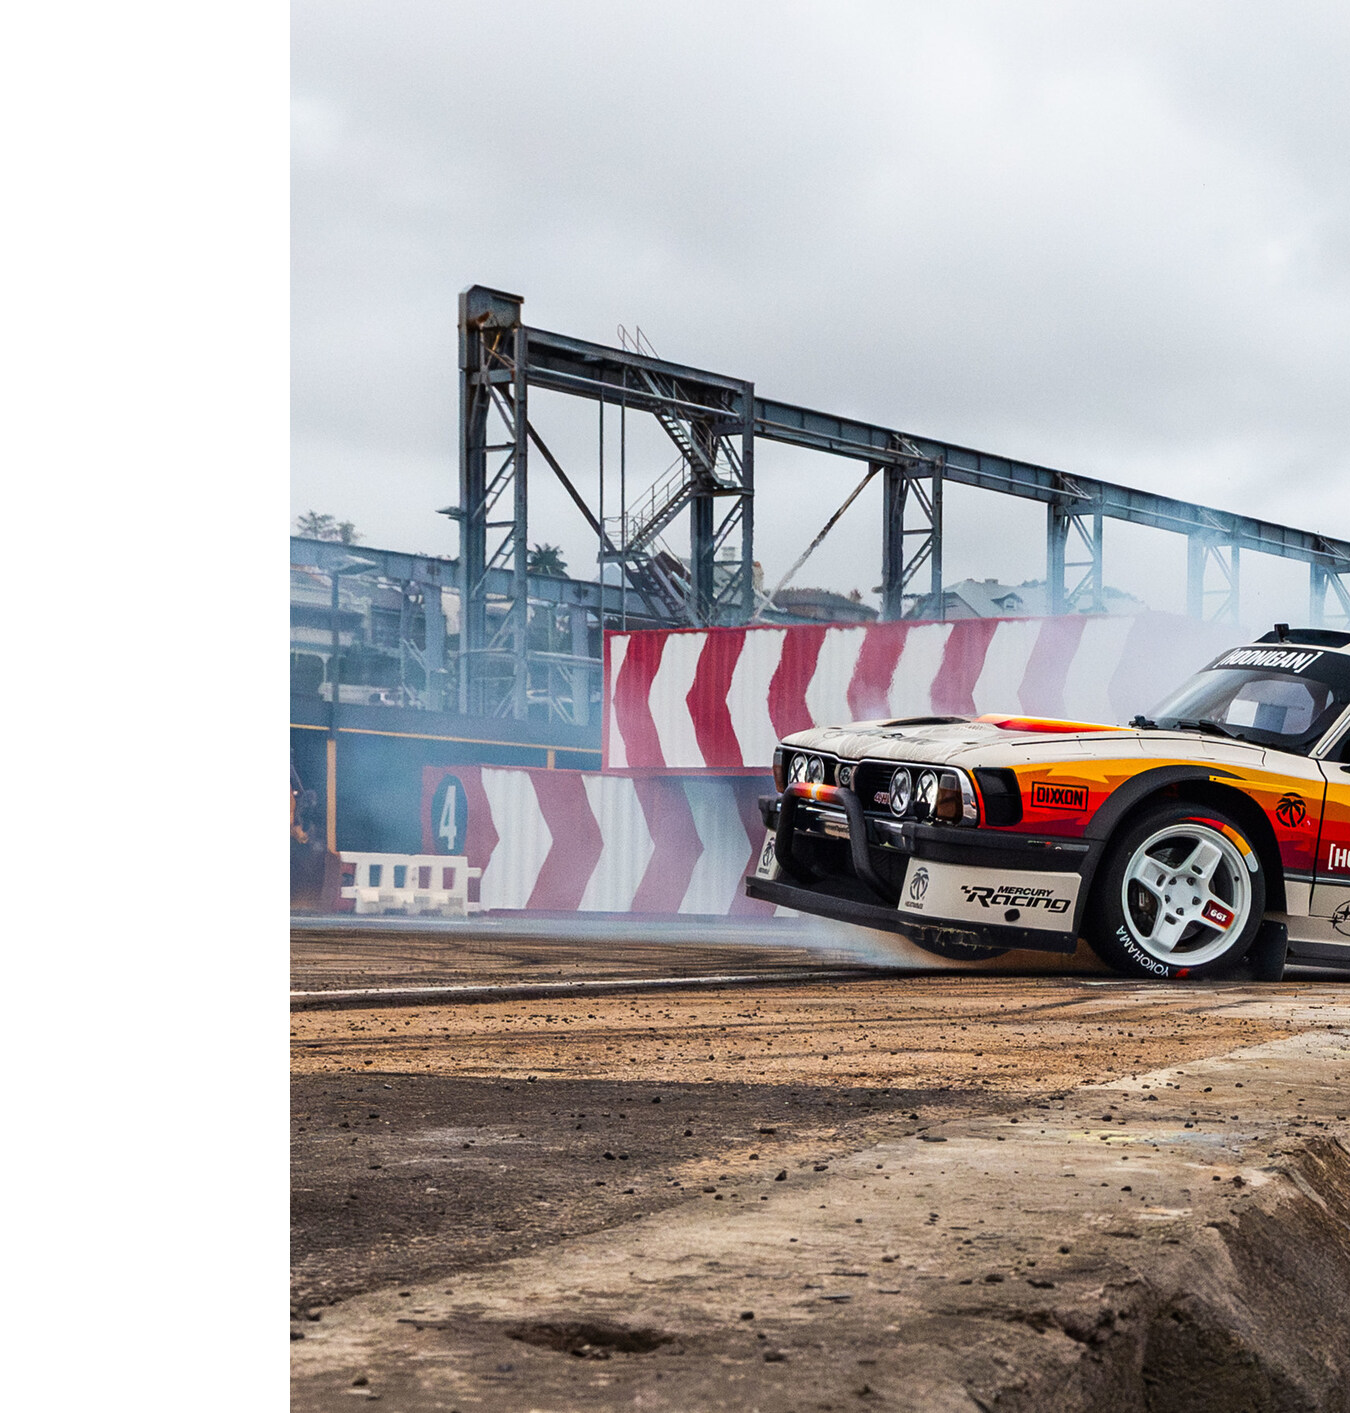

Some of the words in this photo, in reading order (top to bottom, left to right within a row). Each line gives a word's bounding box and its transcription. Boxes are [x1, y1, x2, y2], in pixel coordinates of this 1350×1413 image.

[1036, 786, 1084, 808] DIXXON
[439, 785, 458, 851] 4
[962, 886, 1071, 913] Racing
[997, 886, 1054, 897] MERCURY
[1210, 909, 1227, 923] 199
[1116, 925, 1169, 977] YOKOHAMA
